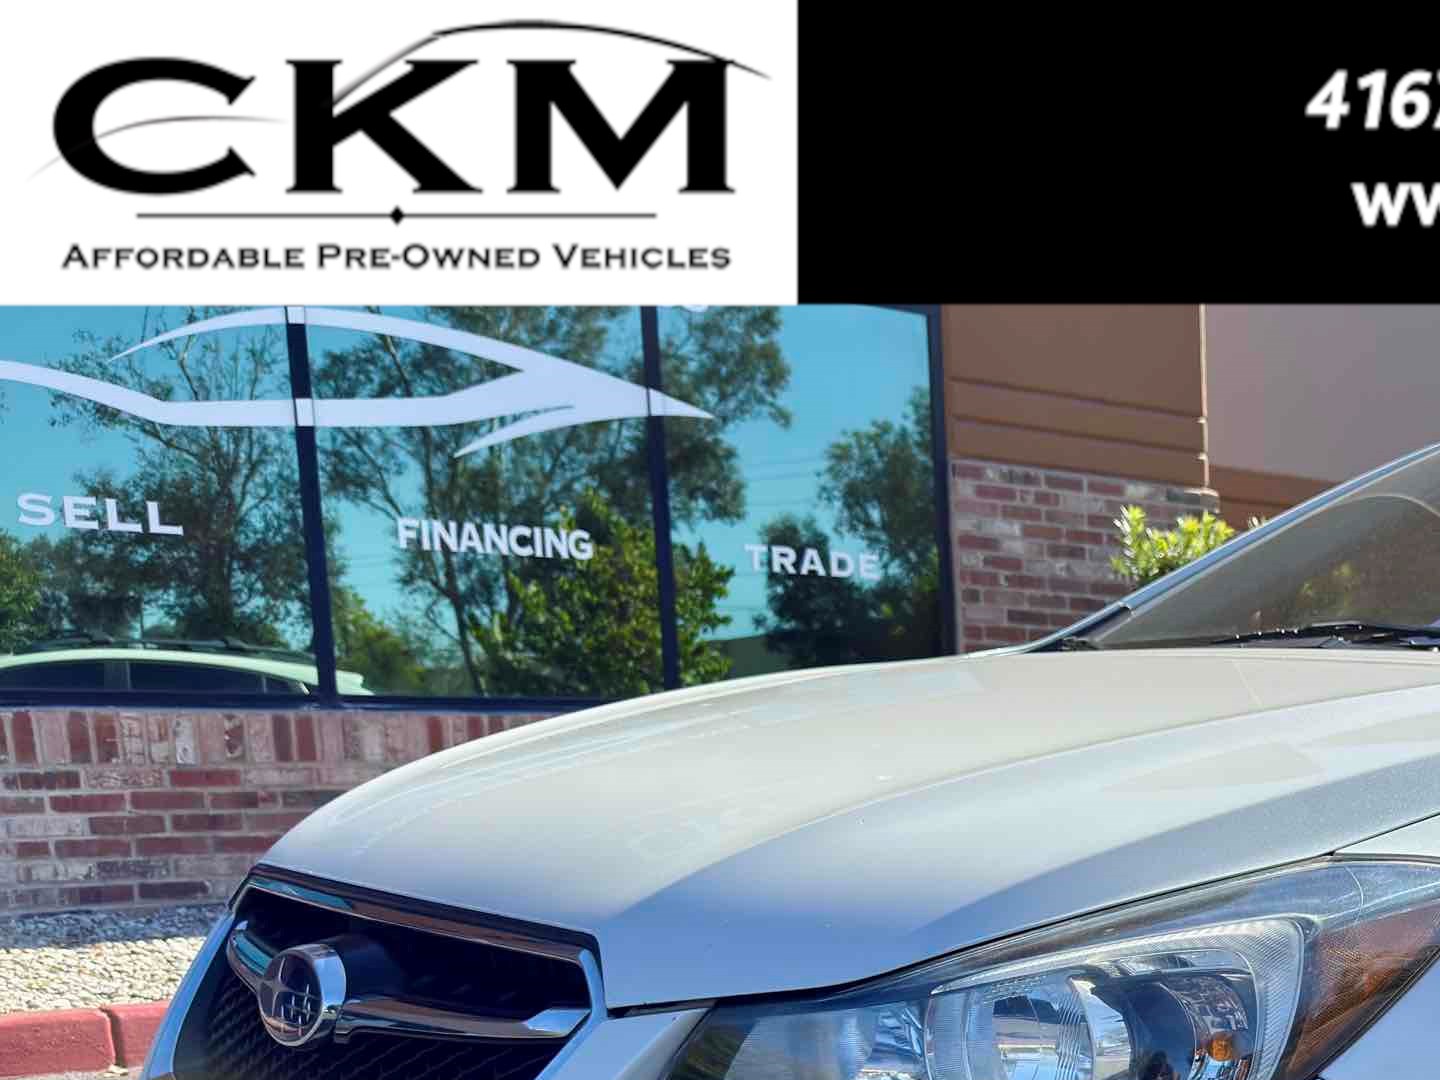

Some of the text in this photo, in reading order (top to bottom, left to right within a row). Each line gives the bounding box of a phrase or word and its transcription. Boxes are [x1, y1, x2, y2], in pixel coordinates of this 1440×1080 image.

[18, 493, 184, 536] SELL
[397, 516, 594, 560] FINANCING
[744, 543, 880, 581] TRADE
